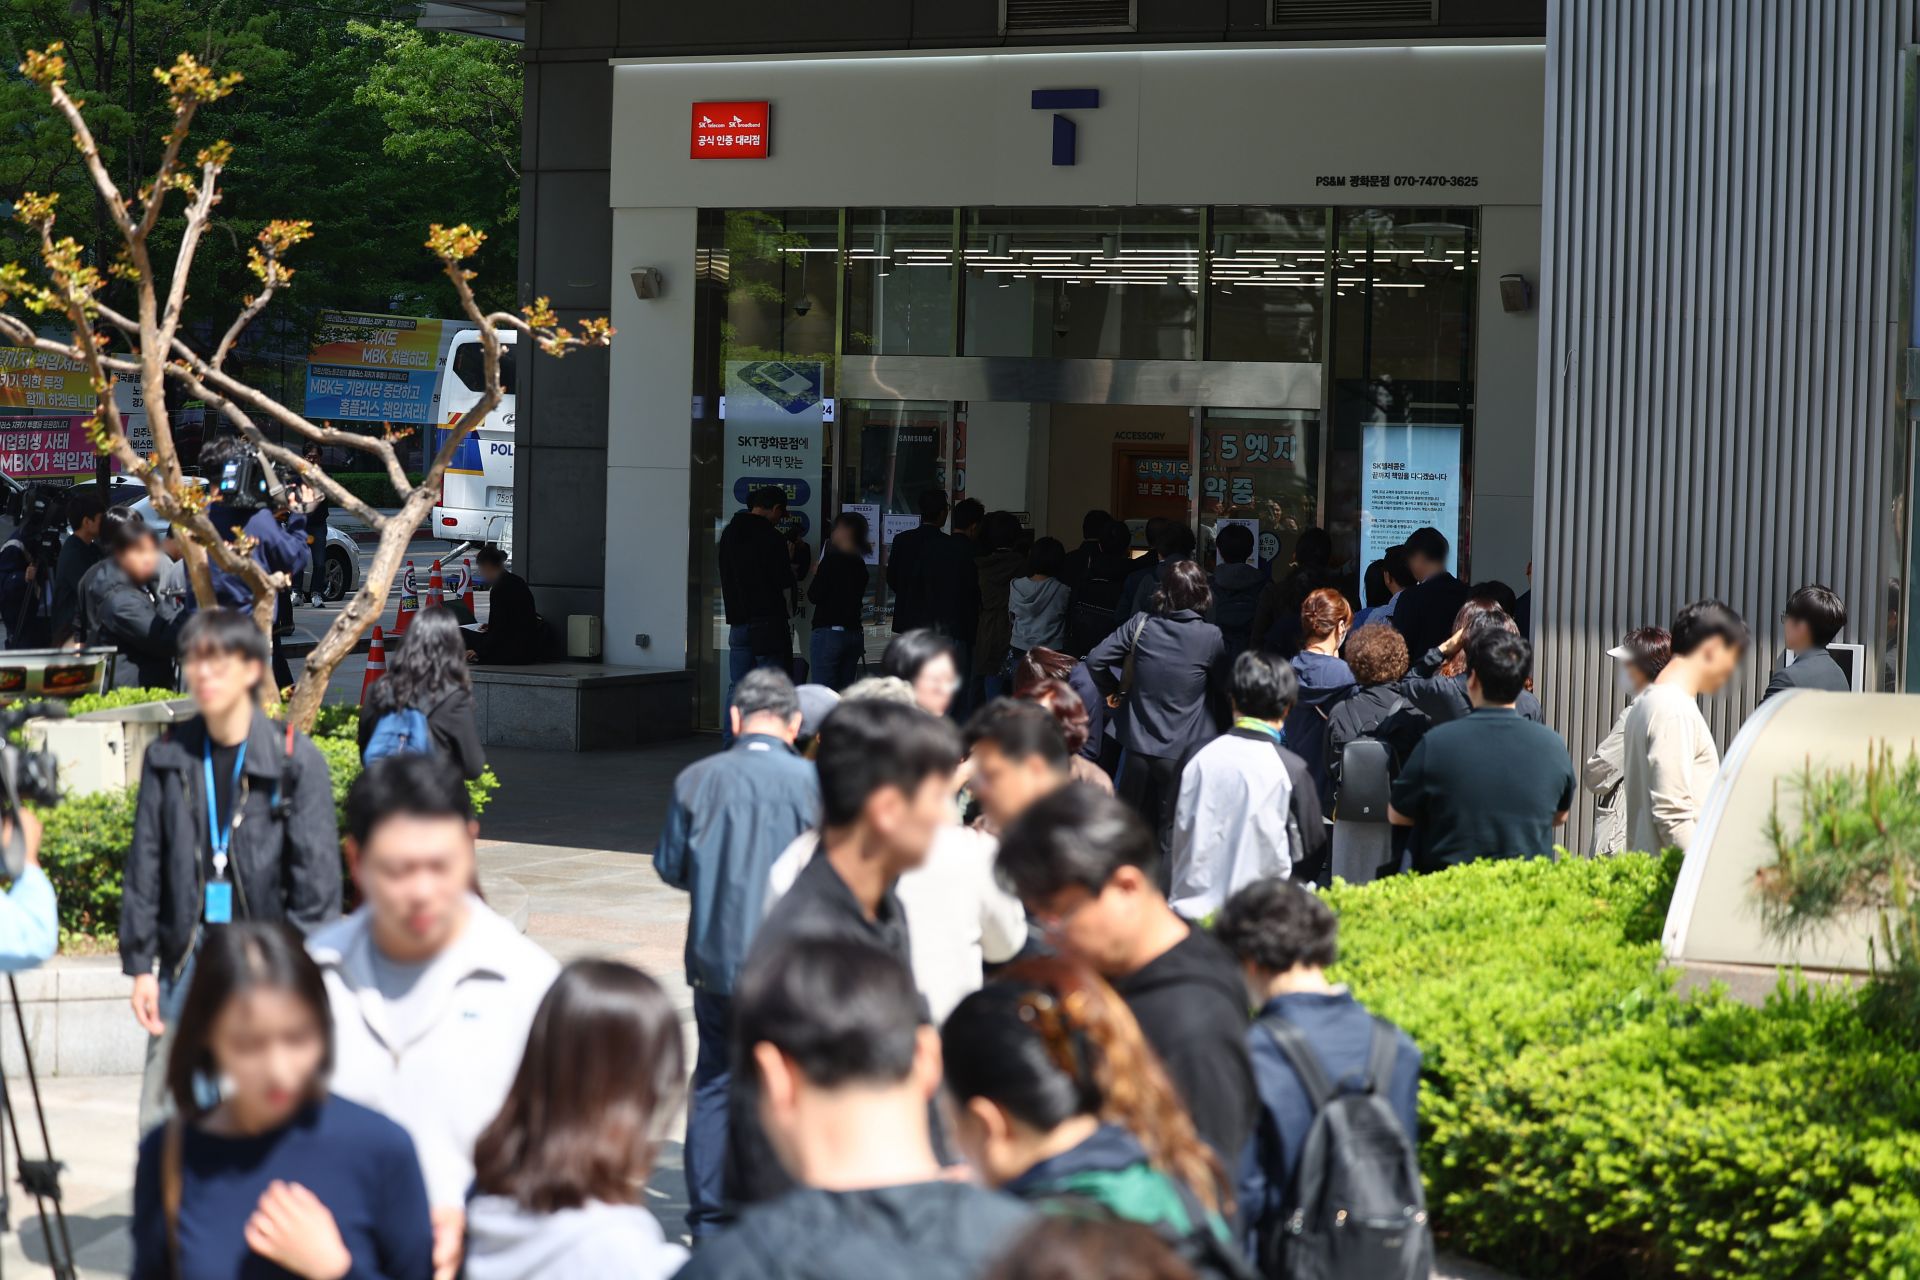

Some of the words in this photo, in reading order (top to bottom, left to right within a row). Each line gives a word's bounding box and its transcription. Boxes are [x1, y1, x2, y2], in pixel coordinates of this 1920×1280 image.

[1031, 89, 1100, 166] T
[698, 135, 715, 146] 공식
[716, 135, 734, 146] 인증
[735, 135, 761, 146] 대리점
[1315, 176, 1346, 187] PS&M
[1350, 175, 1390, 187] 광화문점
[1393, 176, 1479, 187] 070-7470-3625
[361, 348, 389, 365] MBK
[390, 351, 429, 366] 처벌하라
[22, 374, 41, 389] 위한
[44, 375, 64, 390] 투쟁
[310, 378, 345, 396] MBK는
[345, 380, 383, 398] 기업사냥
[383, 382, 421, 400] 중단하고
[25, 391, 46, 406] 함께
[48, 392, 97, 408] 하겠습니다
[340, 399, 380, 417] 홈플러스
[383, 401, 427, 419] 책임져라!
[45, 433, 70, 450] 사태
[738, 436, 809, 450] SKT광화문점에
[898, 434, 933, 443] SAMSUNG
[1114, 431, 1166, 440] ACCESSORY
[0, 452, 49, 472] MBK가
[53, 451, 96, 471] 책임져
[742, 455, 771, 468] 나에게
[784, 456, 804, 469] 맞는
